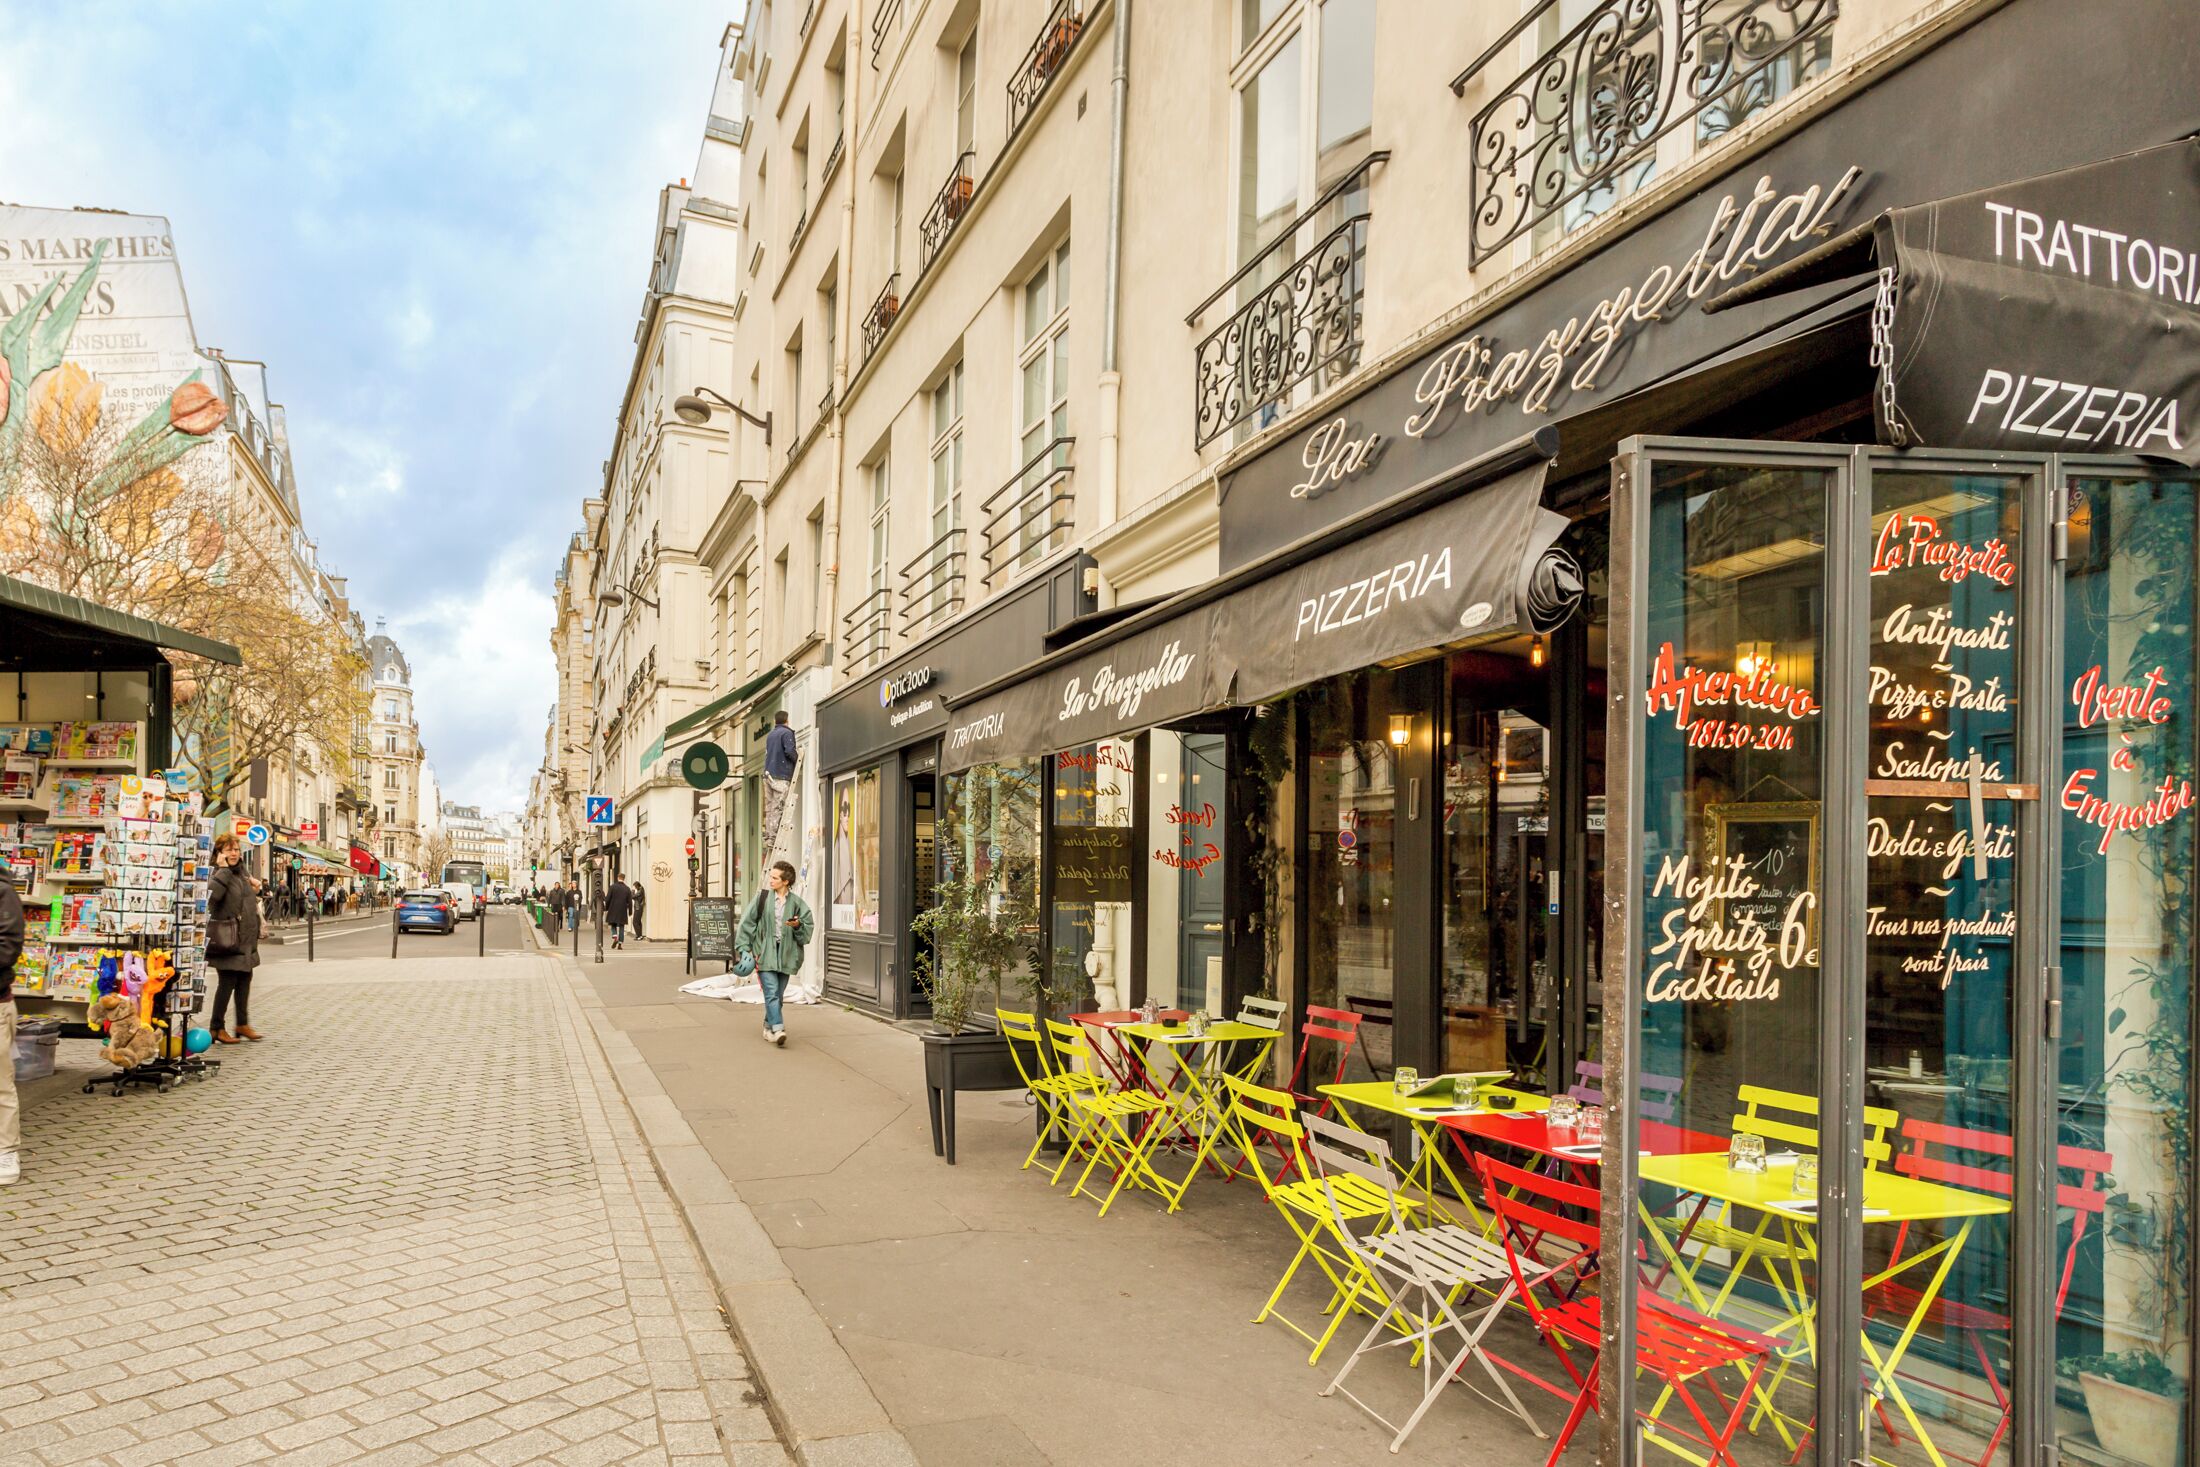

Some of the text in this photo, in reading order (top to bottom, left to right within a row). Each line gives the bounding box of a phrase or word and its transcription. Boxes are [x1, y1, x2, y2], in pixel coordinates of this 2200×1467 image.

[1984, 202, 2200, 306] TRATTORI
[1289, 164, 1864, 499] La Piazzetta
[1967, 368, 2184, 450] PIZZERIA
[1869, 511, 2017, 586] La Piazzetta
[1294, 546, 1453, 642] PIZZERIA
[1882, 603, 2015, 663] Antipasti
[1058, 639, 1197, 722] La Piazzetta
[1645, 641, 1823, 731] Aperitivo
[1868, 666, 2008, 721] Pizza & Pasta
[2072, 663, 2172, 730] Vente
[950, 711, 1005, 750] TRATTORIA
[2110, 733, 2136, 772] à
[1866, 816, 1933, 857] Dolci
[1932, 841, 1946, 859] &
[2060, 767, 2196, 855] Emporter
[1652, 852, 1760, 923] Mojito
[1651, 908, 1776, 971] Spritz
[1866, 906, 2016, 949] Tous nos produits
[1646, 957, 1780, 1003] Cocktails
[1901, 948, 1990, 991] sont frais
